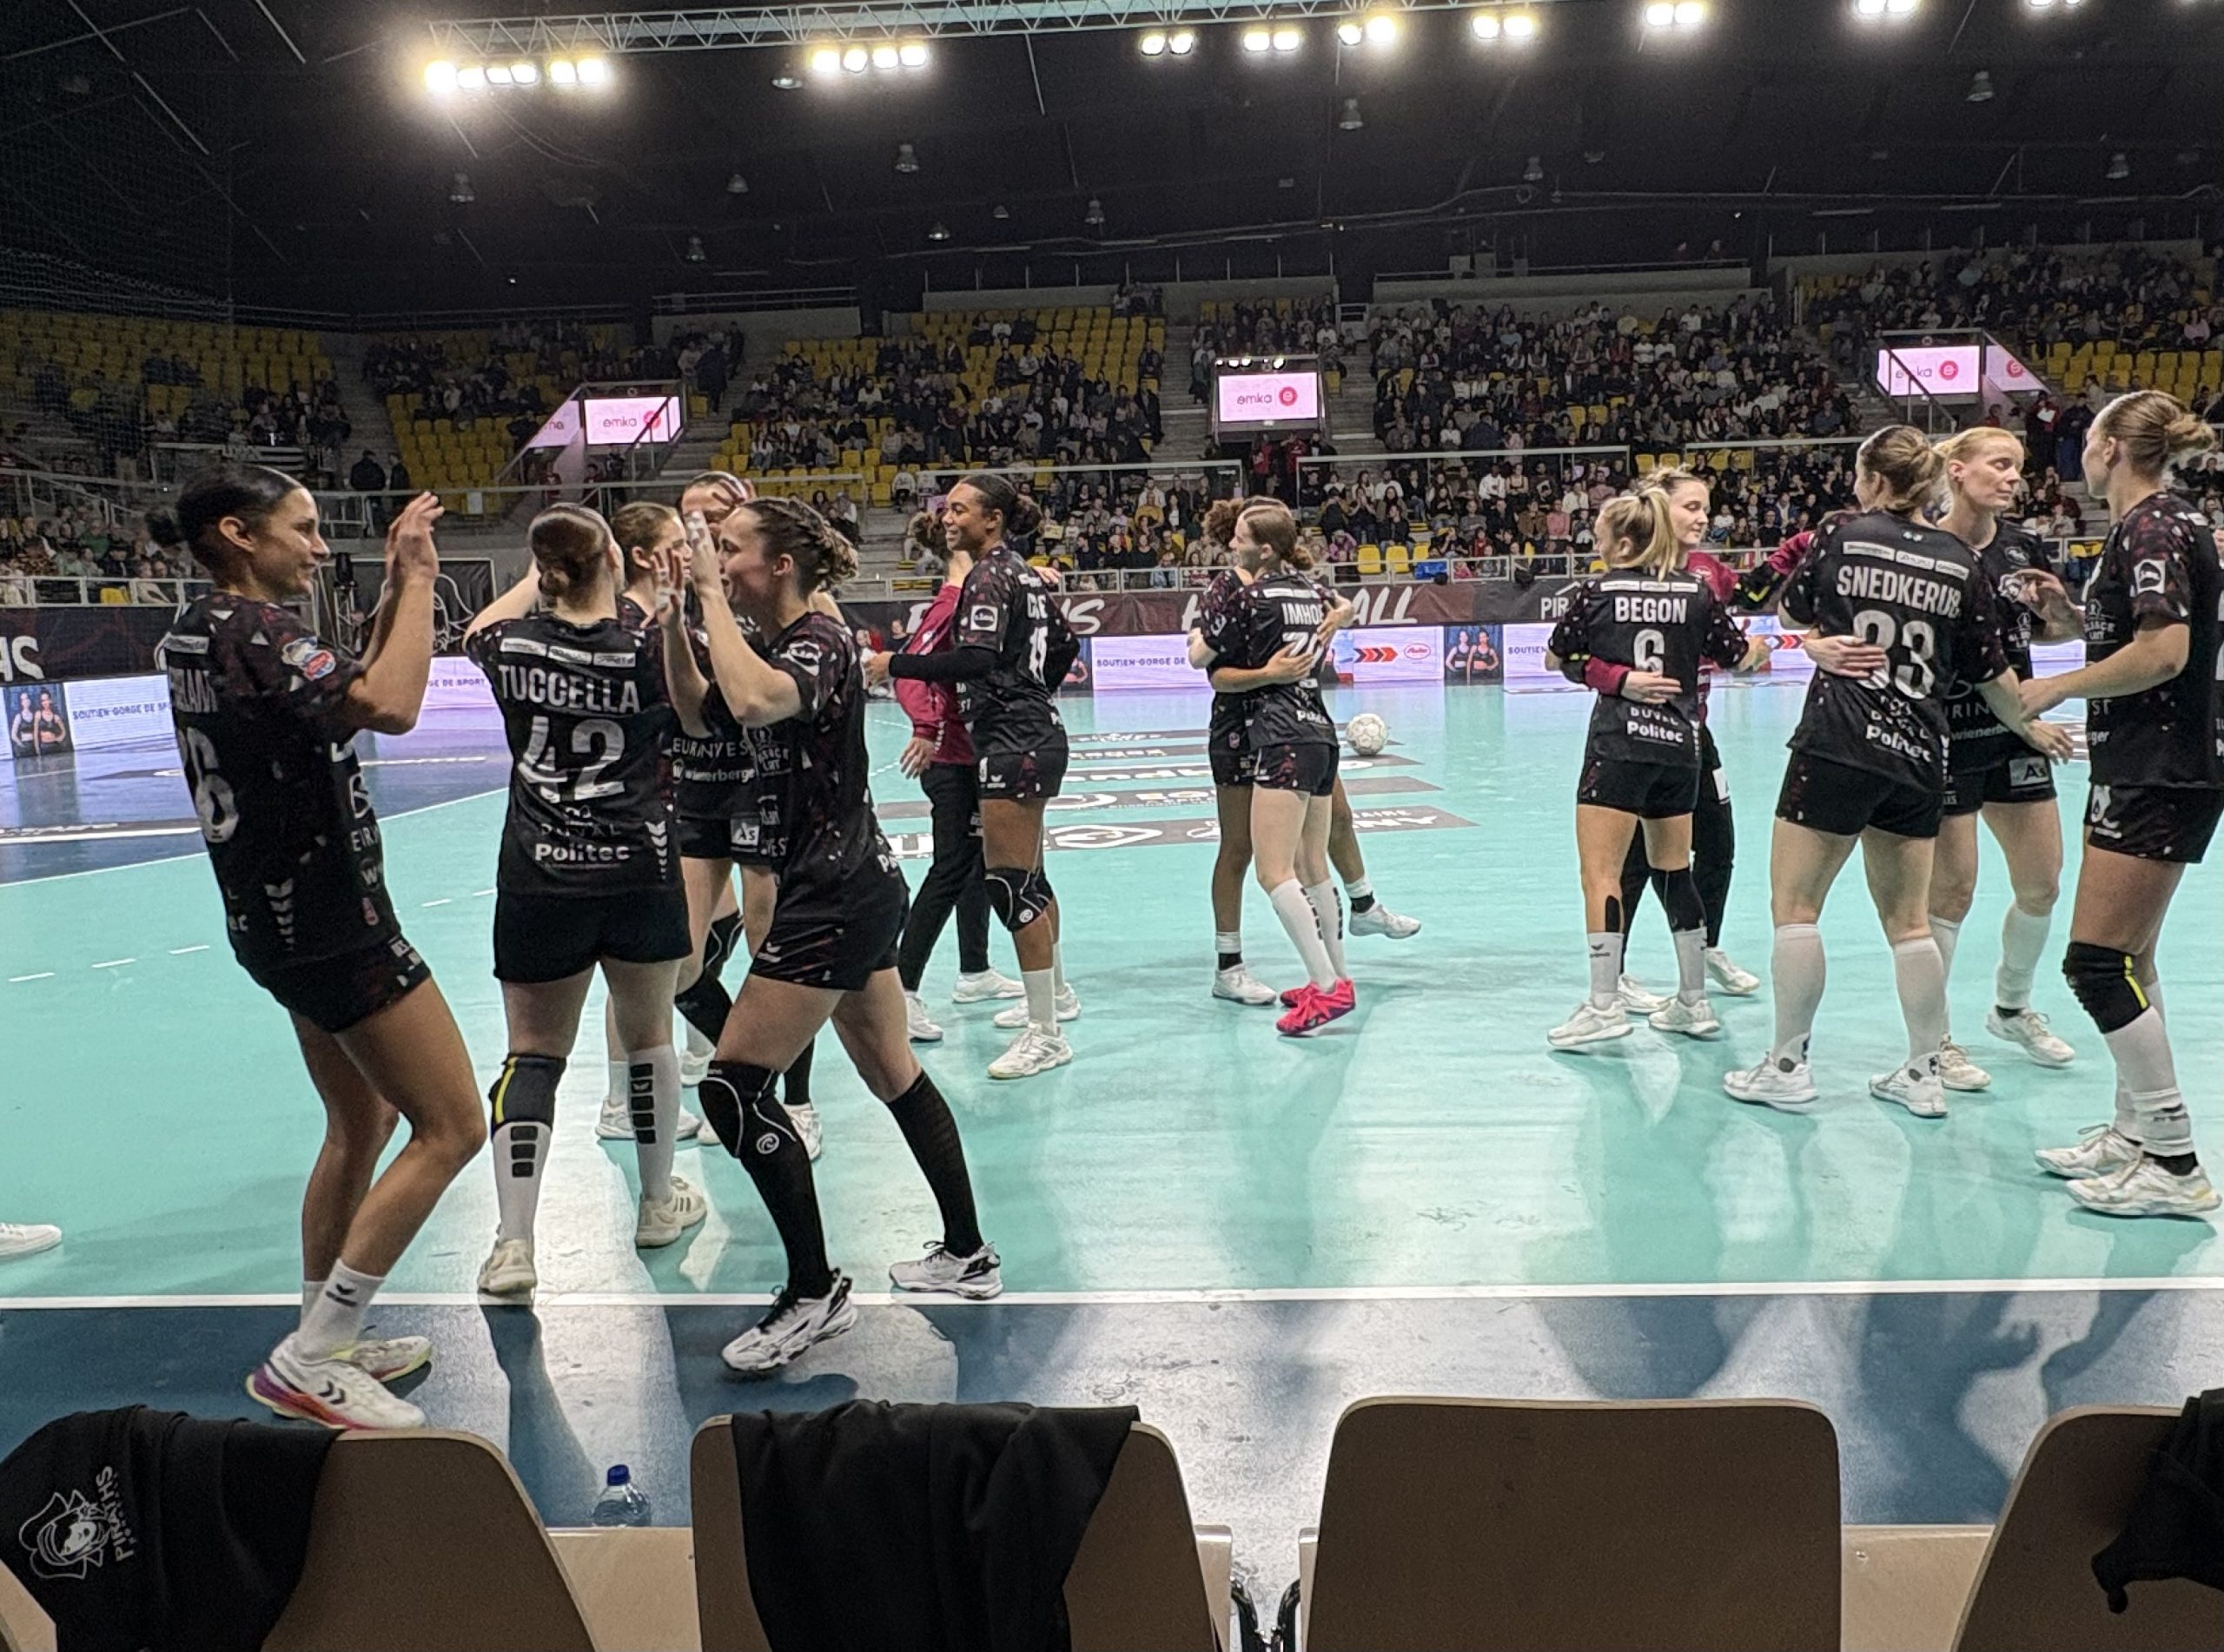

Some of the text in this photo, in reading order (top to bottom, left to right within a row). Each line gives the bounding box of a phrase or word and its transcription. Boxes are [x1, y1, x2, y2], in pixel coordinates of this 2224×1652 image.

[1895, 366, 1932, 379] eka
[1237, 393, 1273, 405] emka
[603, 418, 638, 428] emka
[1614, 597, 1687, 624] BEGON
[1633, 629, 1665, 673] 6
[1096, 657, 1186, 667] SOUTIEN-GORGE DE
[499, 664, 641, 714] TUCCELLA
[1626, 721, 1684, 743] Politec
[518, 716, 626, 804] 42
[535, 843, 631, 862] Politec
